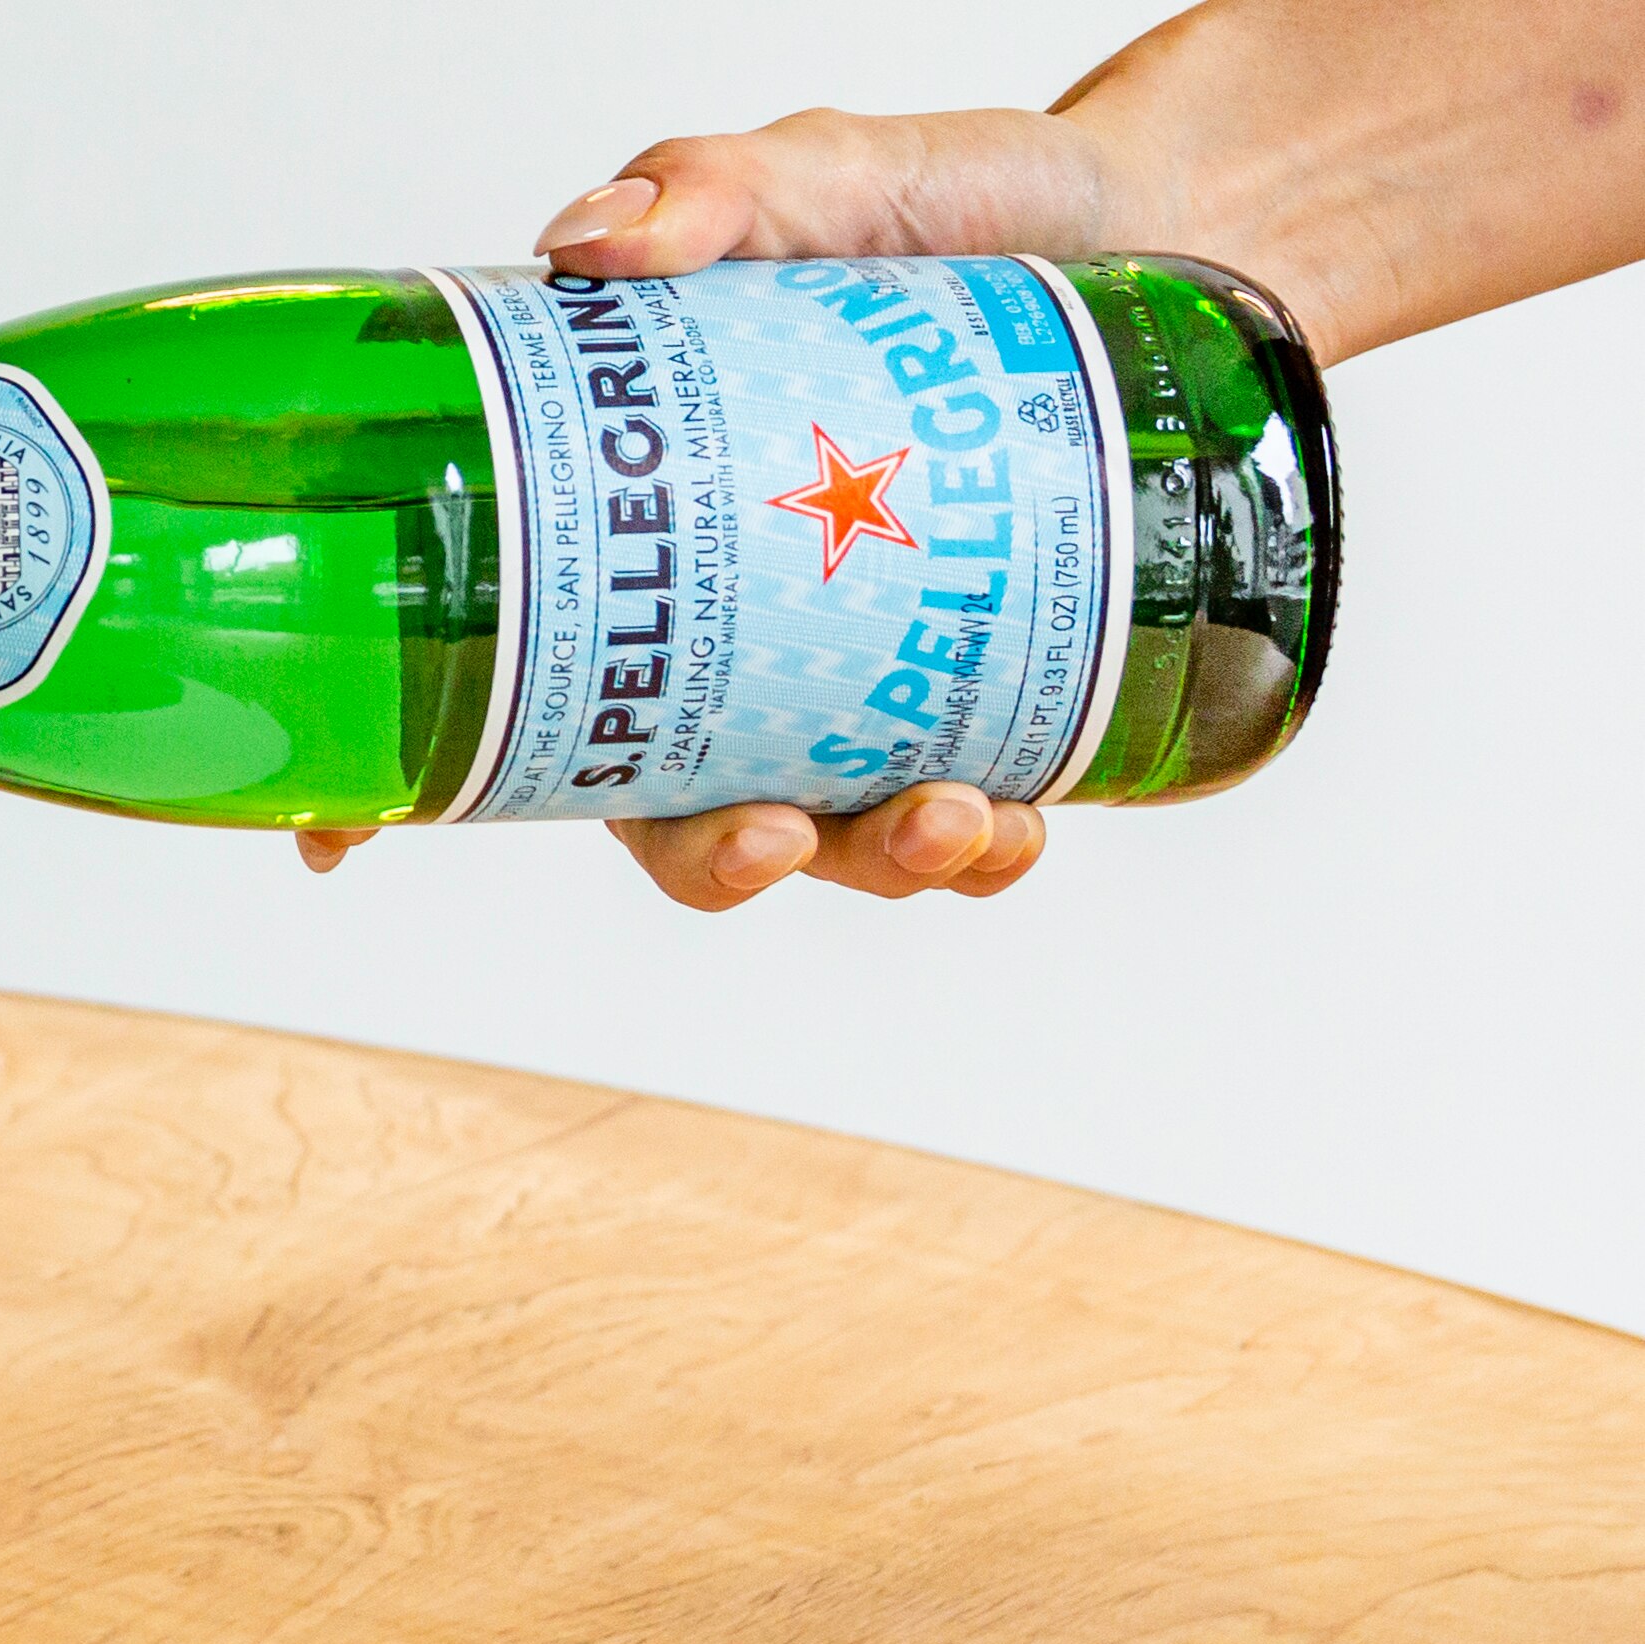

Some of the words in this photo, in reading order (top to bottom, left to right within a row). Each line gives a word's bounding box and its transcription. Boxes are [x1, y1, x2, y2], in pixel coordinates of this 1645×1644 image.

[627, 279, 675, 331] WATE
[965, 312, 989, 336] BEST
[680, 316, 706, 354] ADDED
[520, 332, 558, 392] TERME
[663, 339, 711, 460] MINERAL
[1055, 377, 1078, 413] RECYCLE
[709, 391, 731, 457] NATURAL
[1062, 416, 1085, 447] PLEASE
[541, 400, 578, 545] PELLEGRINO
[718, 465, 737, 506] WITH
[25, 477, 52, 566] 1899
[722, 507, 740, 568] WATER
[1051, 495, 1080, 531] mL)
[691, 474, 719, 621] NATURAL
[1051, 541, 1080, 590] (750
[556, 557, 579, 610] SAN
[719, 574, 739, 645] MINERAL
[1050, 595, 1080, 633] OZ)
[542, 623, 581, 721] SOURCE,
[1046, 637, 1073, 665] FL
[660, 636, 715, 771] SPARKLING
[708, 650, 733, 714] NATURAL
[1040, 667, 1068, 702] 9.3
[1031, 701, 1064, 726] PT,
[531, 726, 561, 760] THE
[1014, 747, 1044, 769] OZ
[524, 763, 549, 783] AT
